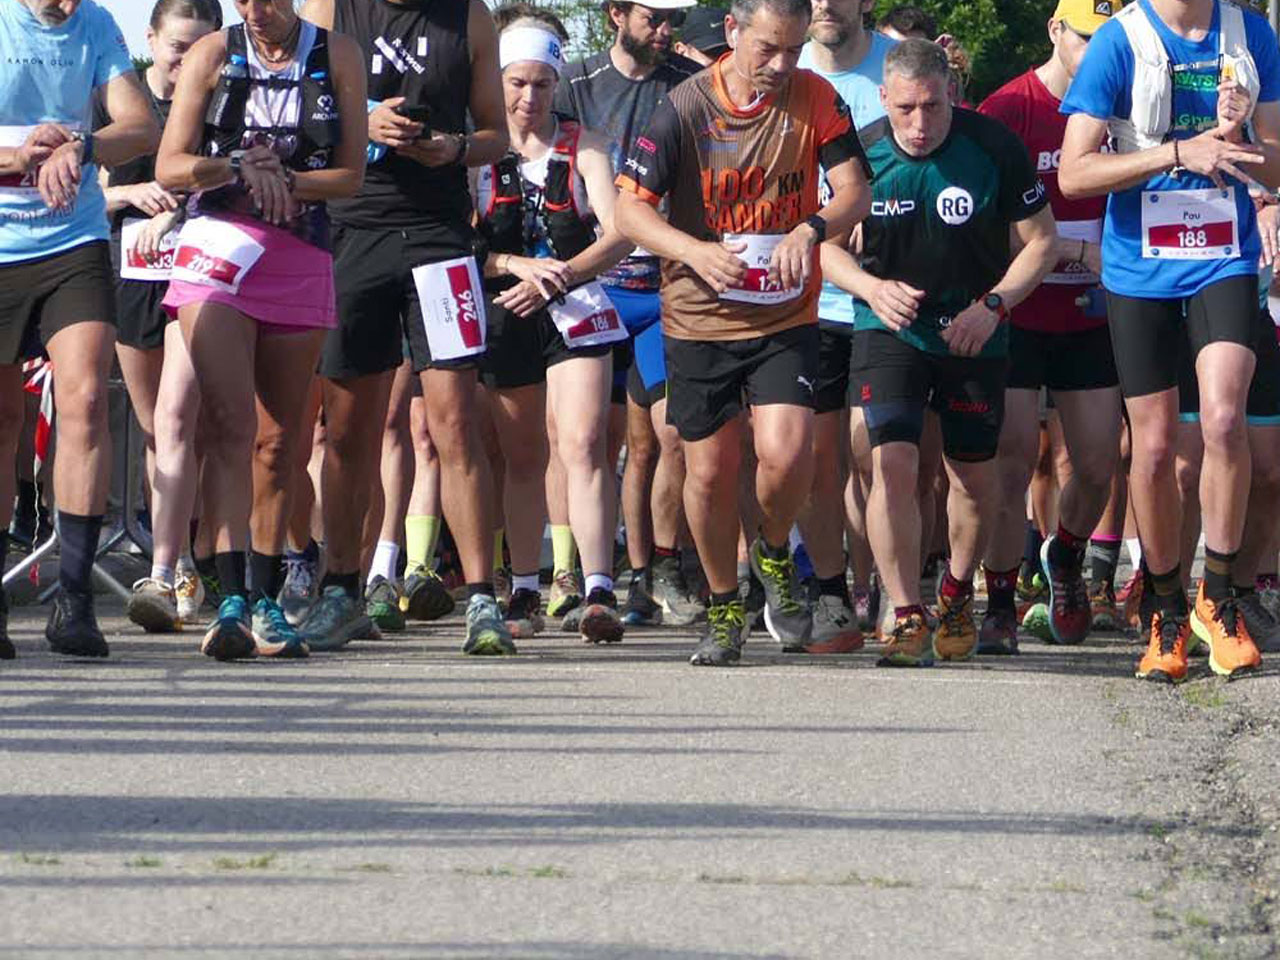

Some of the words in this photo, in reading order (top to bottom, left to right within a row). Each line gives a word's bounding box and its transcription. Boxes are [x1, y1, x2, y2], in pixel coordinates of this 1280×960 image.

[871, 199, 916, 216] CMP
[942, 197, 968, 217] RG
[1177, 230, 1207, 248] 188
[457, 289, 478, 323] 246
